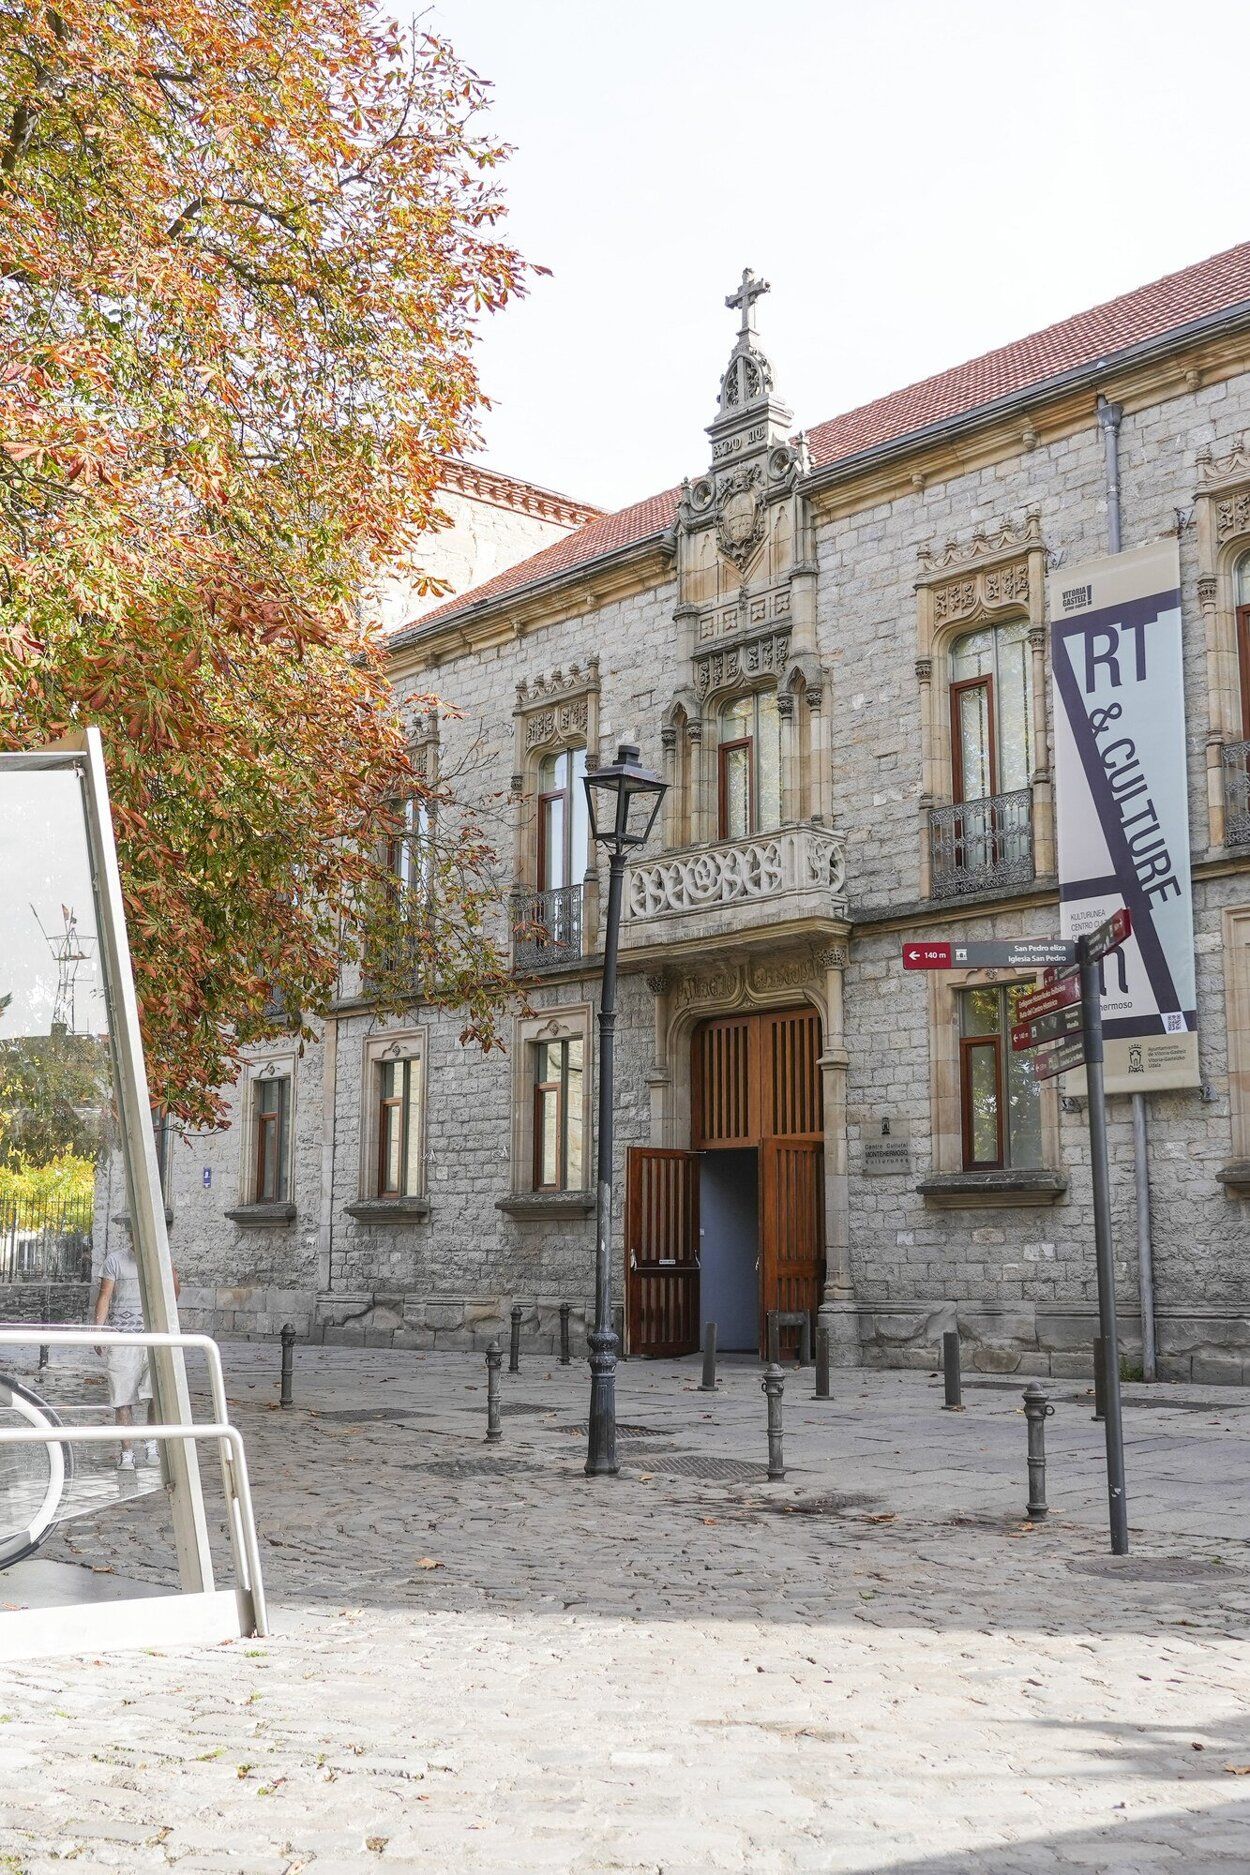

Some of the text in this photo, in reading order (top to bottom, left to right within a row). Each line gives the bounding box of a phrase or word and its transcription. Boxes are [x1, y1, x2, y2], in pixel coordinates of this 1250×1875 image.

[1062, 587, 1086, 599] VITORIA
[1062, 595, 1086, 607] GASTEIZ
[1100, 738, 1182, 910] CULTURE
[1070, 909, 1106, 921] KULTURUNEA
[1071, 920, 1093, 931] CENTRO
[1028, 944, 1049, 952] Pedro
[924, 951, 938, 959] 140
[1008, 954, 1067, 964] Iglesia San Pedro
[865, 1148, 909, 1158] MONTEHERMOSO
